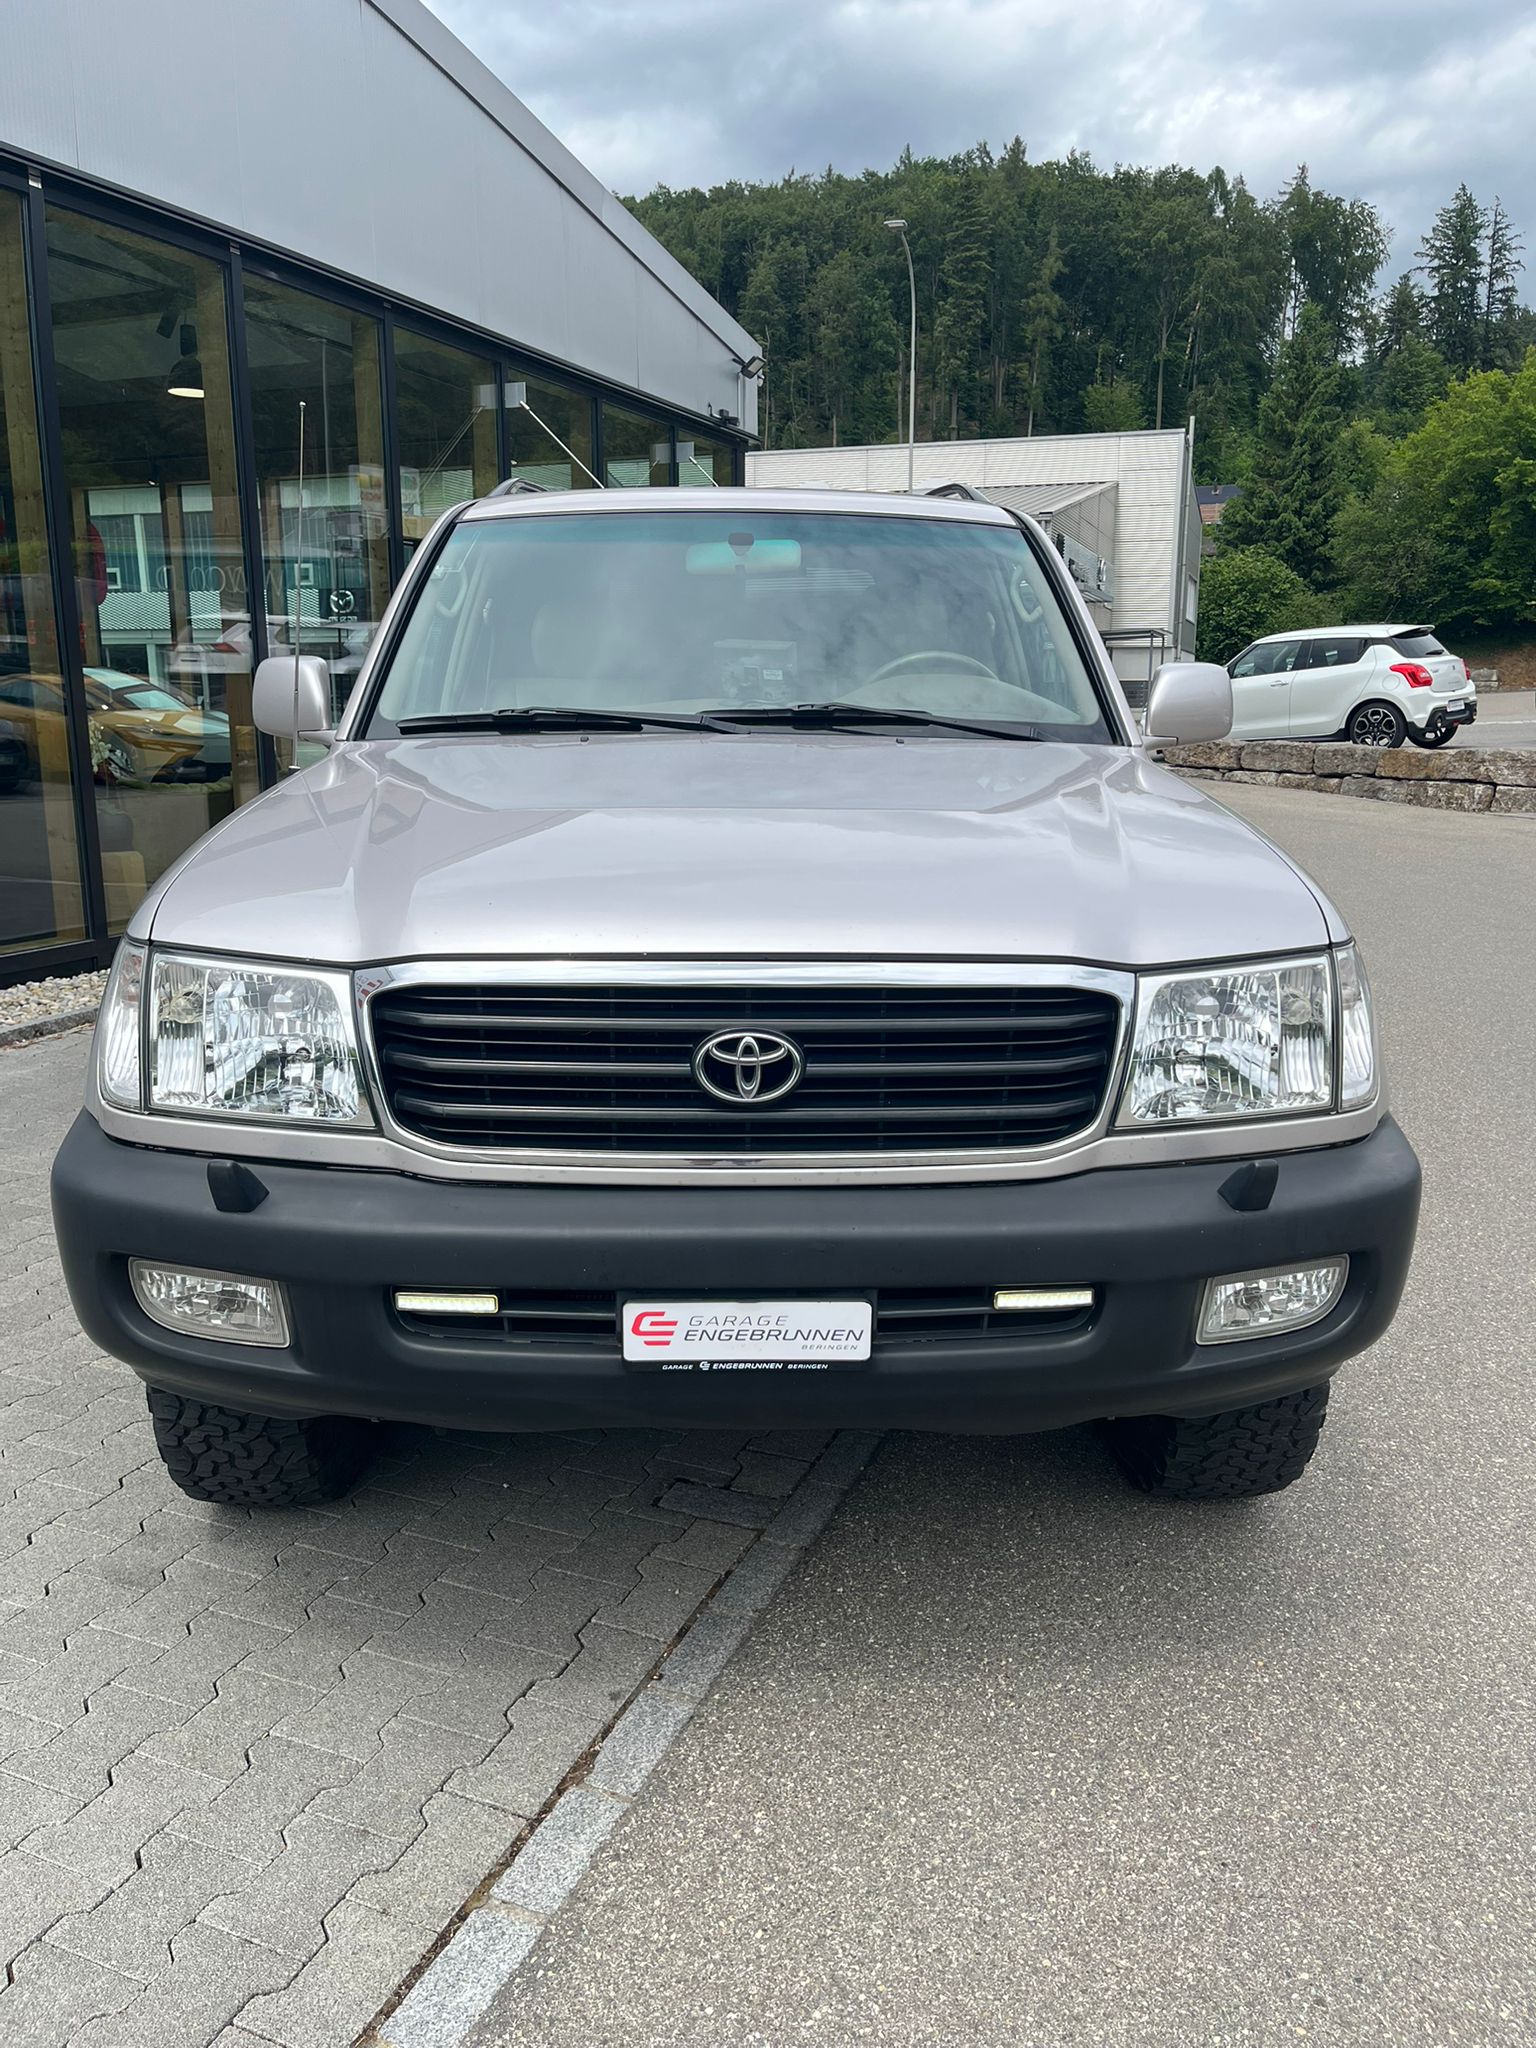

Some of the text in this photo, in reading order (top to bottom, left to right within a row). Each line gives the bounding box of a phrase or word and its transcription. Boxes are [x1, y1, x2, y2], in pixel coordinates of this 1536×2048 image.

[688, 1315, 790, 1327] GARAGE
[684, 1329, 864, 1342] ENGEBRUNNEN
[712, 1362, 784, 1370] ENGEBRUNNEN
